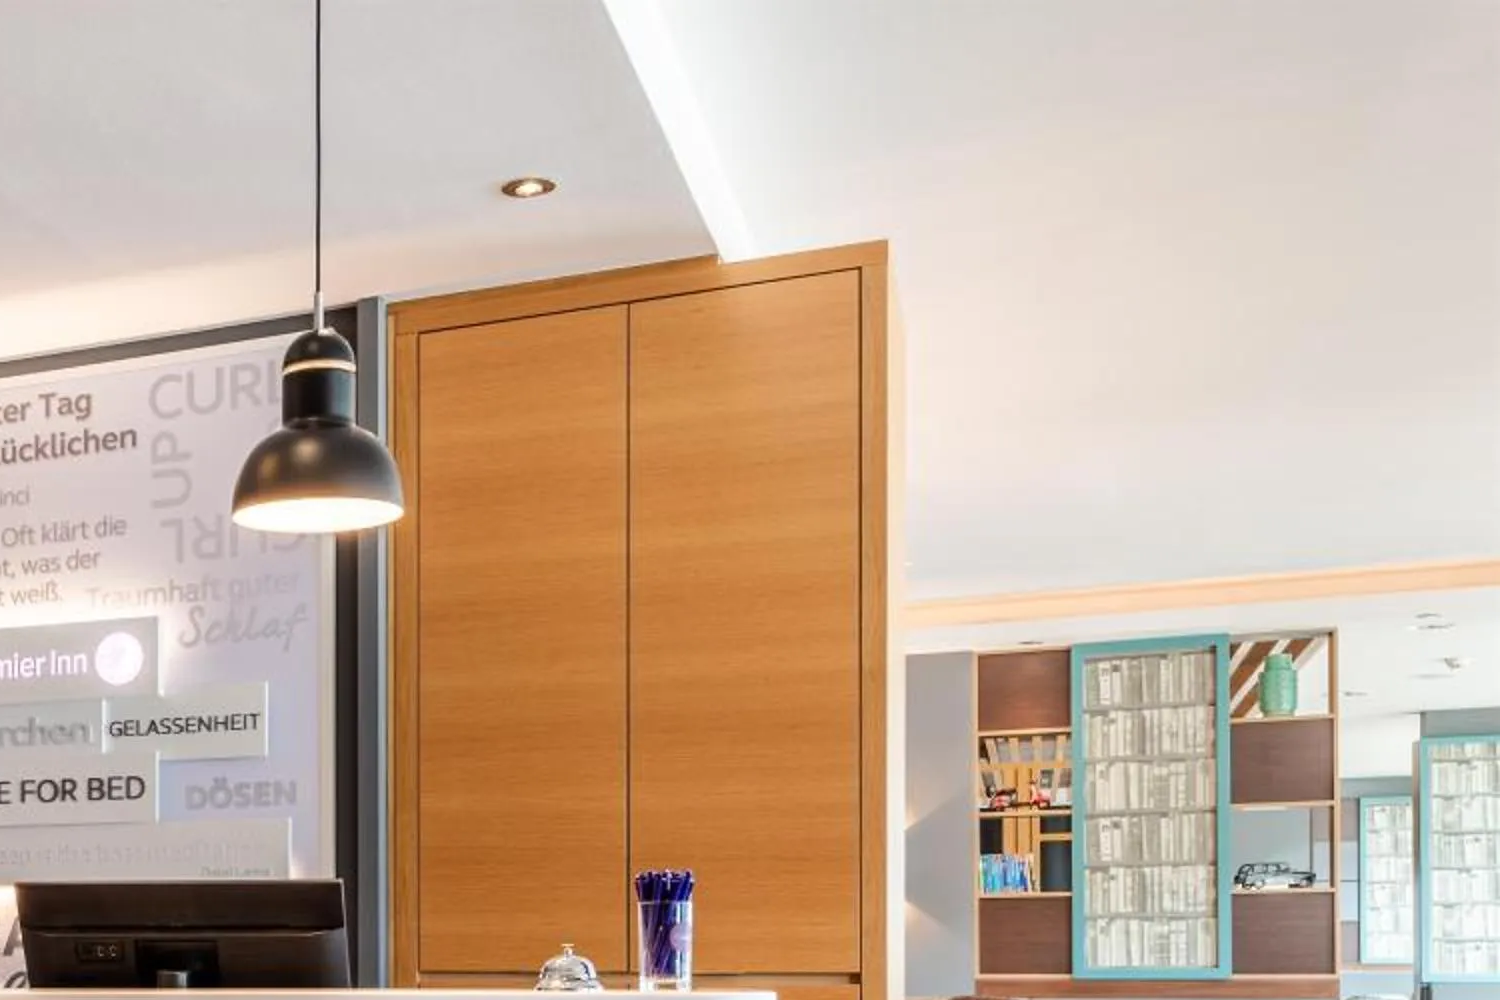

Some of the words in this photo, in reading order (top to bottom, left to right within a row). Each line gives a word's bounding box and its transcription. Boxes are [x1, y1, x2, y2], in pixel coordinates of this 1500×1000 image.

[38, 392, 93, 421] Tag
[152, 431, 192, 509] UP
[1, 524, 36, 548] Oft
[40, 520, 90, 544] klärt
[94, 514, 128, 538] die
[20, 557, 61, 576] was
[66, 549, 101, 571] der
[179, 602, 308, 652] Schlaf
[50, 649, 88, 676] Inn
[108, 712, 261, 738] GELASSENHEIT
[20, 777, 78, 804] FOR
[87, 775, 146, 802] BED
[184, 776, 297, 811] DÖSEN
